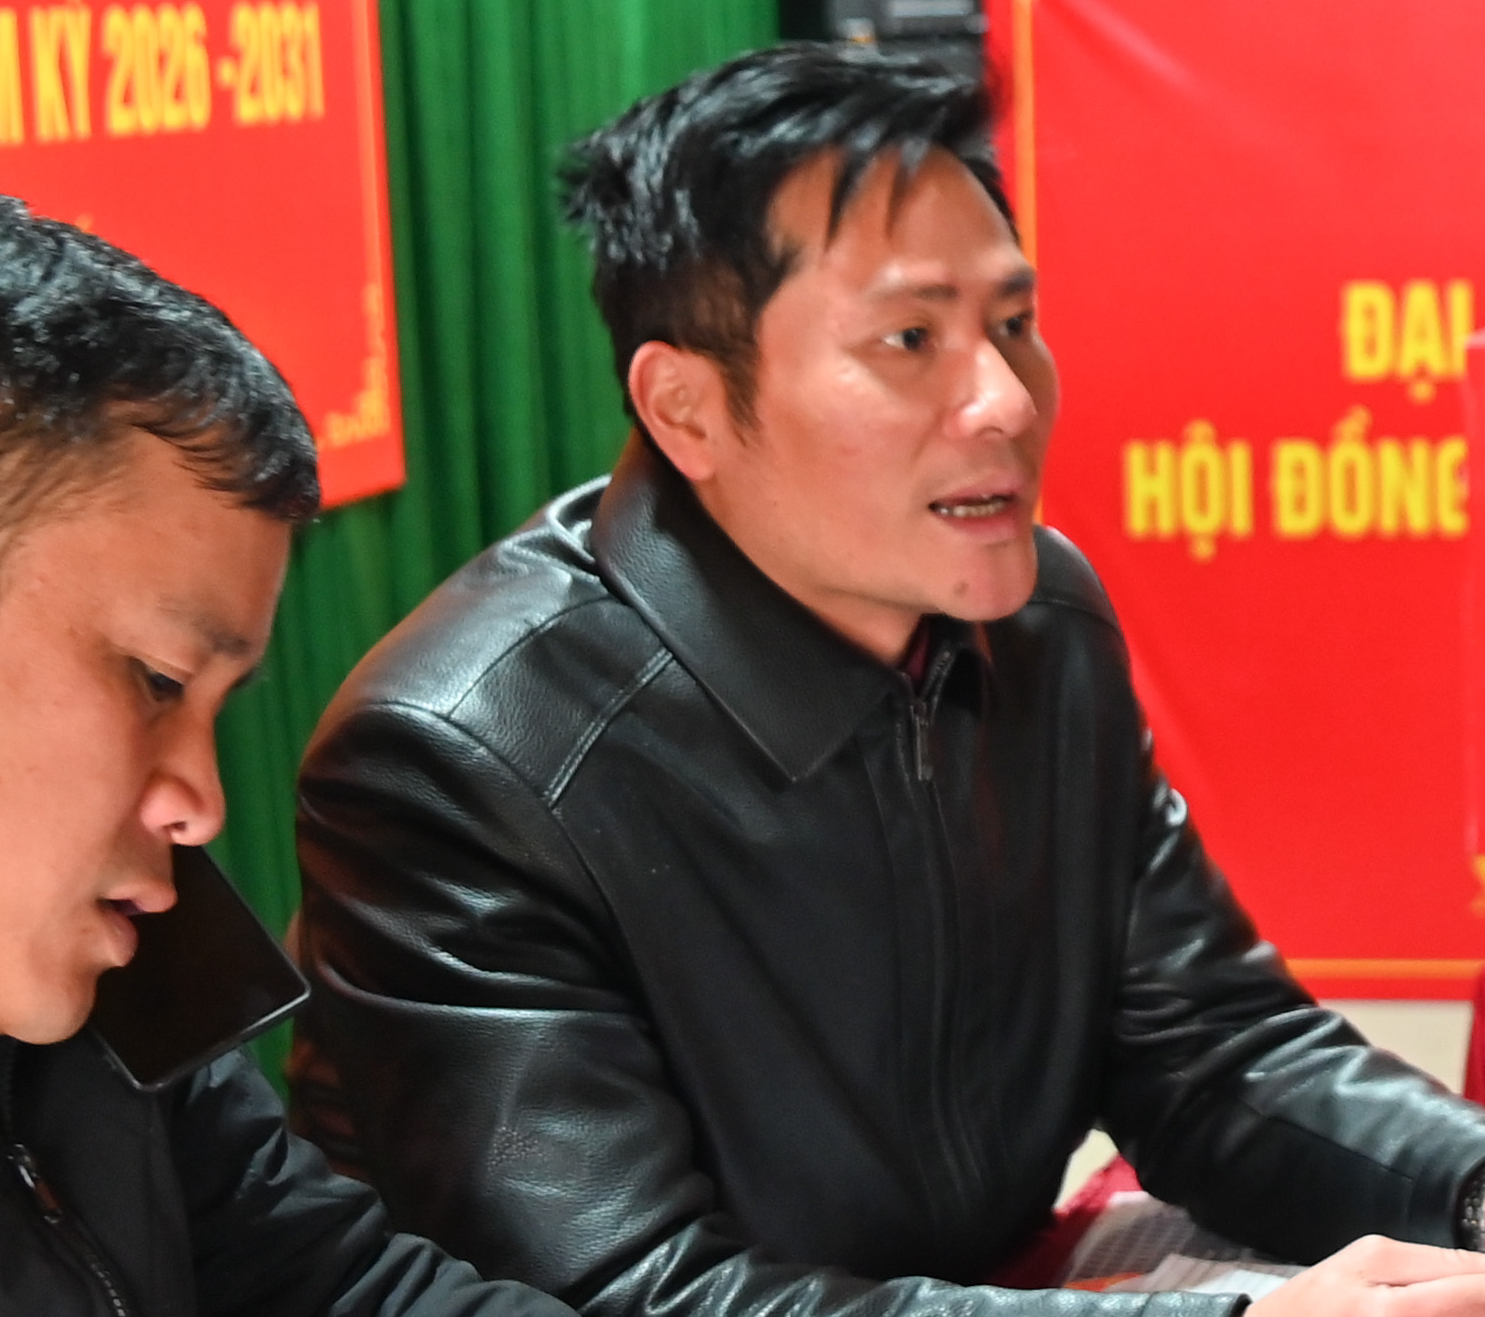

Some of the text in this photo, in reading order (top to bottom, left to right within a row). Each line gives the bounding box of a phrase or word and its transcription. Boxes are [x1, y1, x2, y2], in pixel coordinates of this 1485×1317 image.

[102, 3, 212, 136] 2026
[1338, 279, 1474, 401] ĐẠI
[1123, 420, 1252, 559] HỘI
